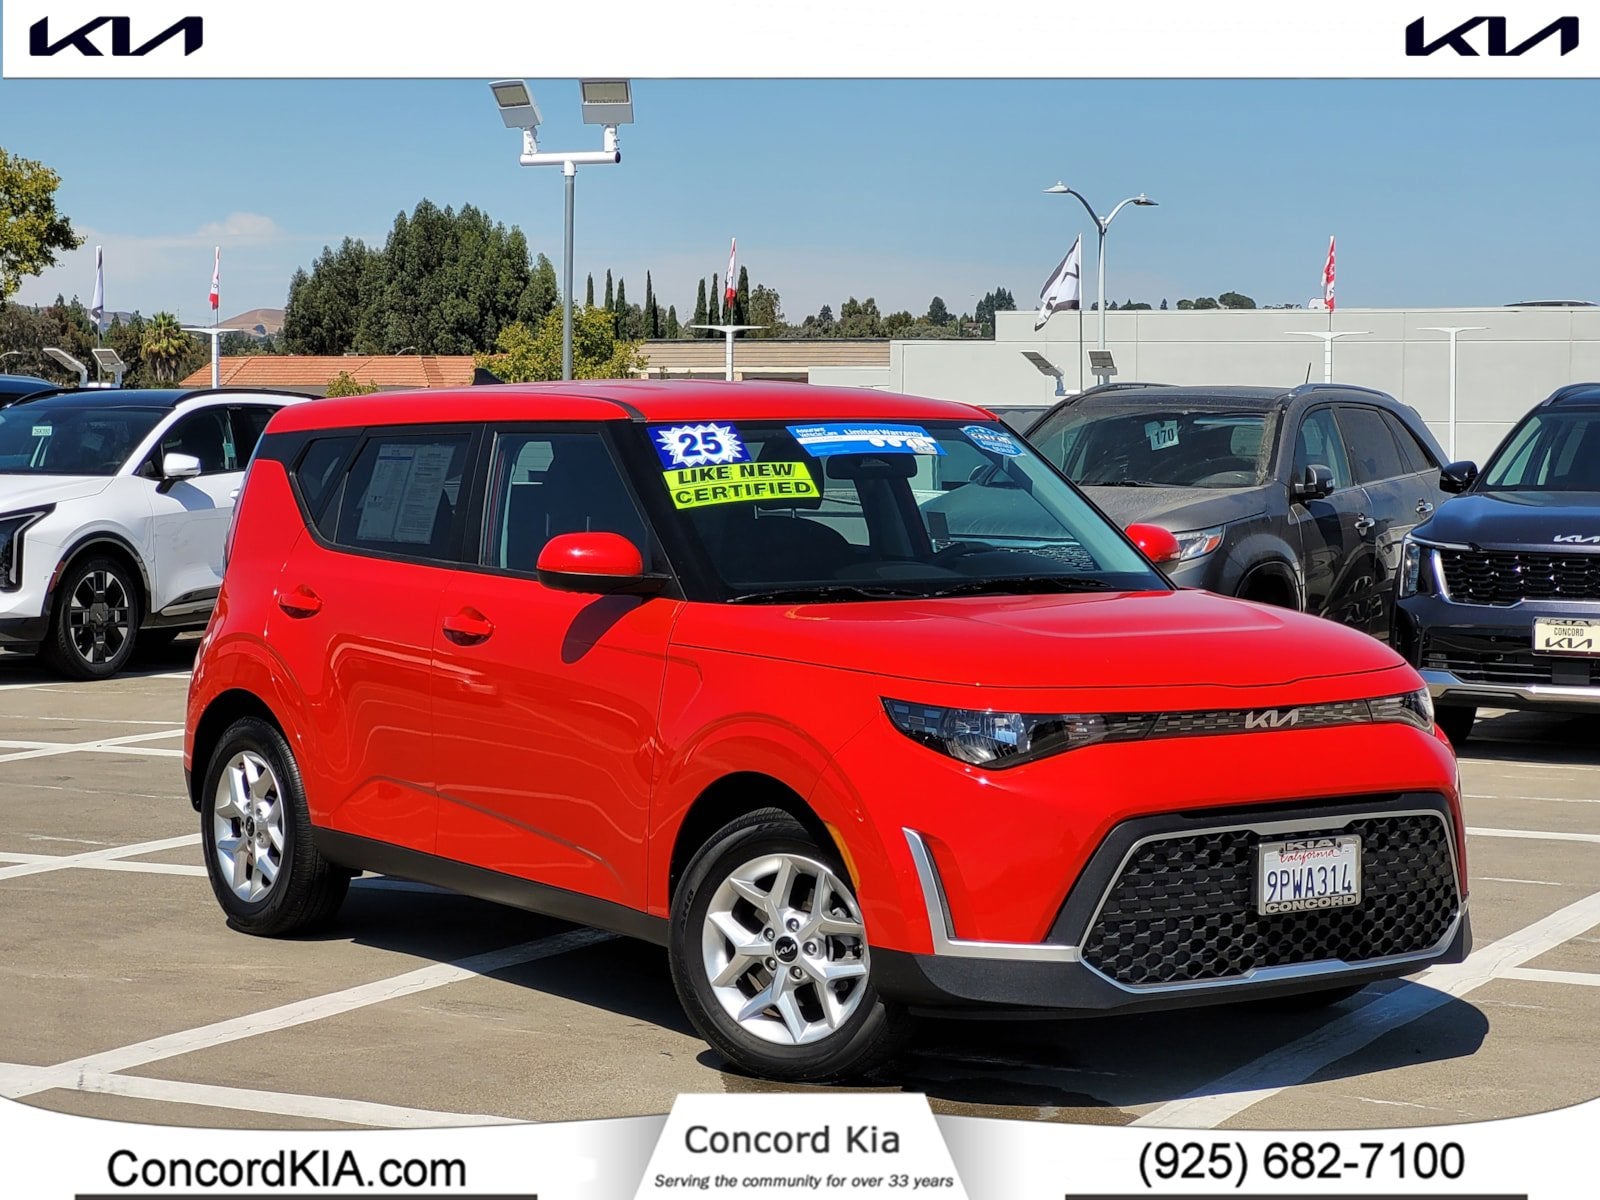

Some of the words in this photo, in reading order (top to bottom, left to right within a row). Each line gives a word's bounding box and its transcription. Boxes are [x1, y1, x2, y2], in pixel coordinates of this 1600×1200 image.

[678, 432, 723, 457] 25
[1154, 428, 1175, 445] 170
[677, 466, 731, 485] LIKE
[739, 463, 794, 478] NEW
[675, 481, 812, 504] CERTIFIED
[1553, 627, 1584, 637] CONCORD
[1545, 637, 1592, 649] KIA
[1245, 709, 1299, 729] KIA
[1285, 839, 1335, 851] KIA
[1280, 848, 1341, 865] California
[1267, 864, 1352, 902] 9PWA314
[1265, 894, 1356, 914] CONCORD
